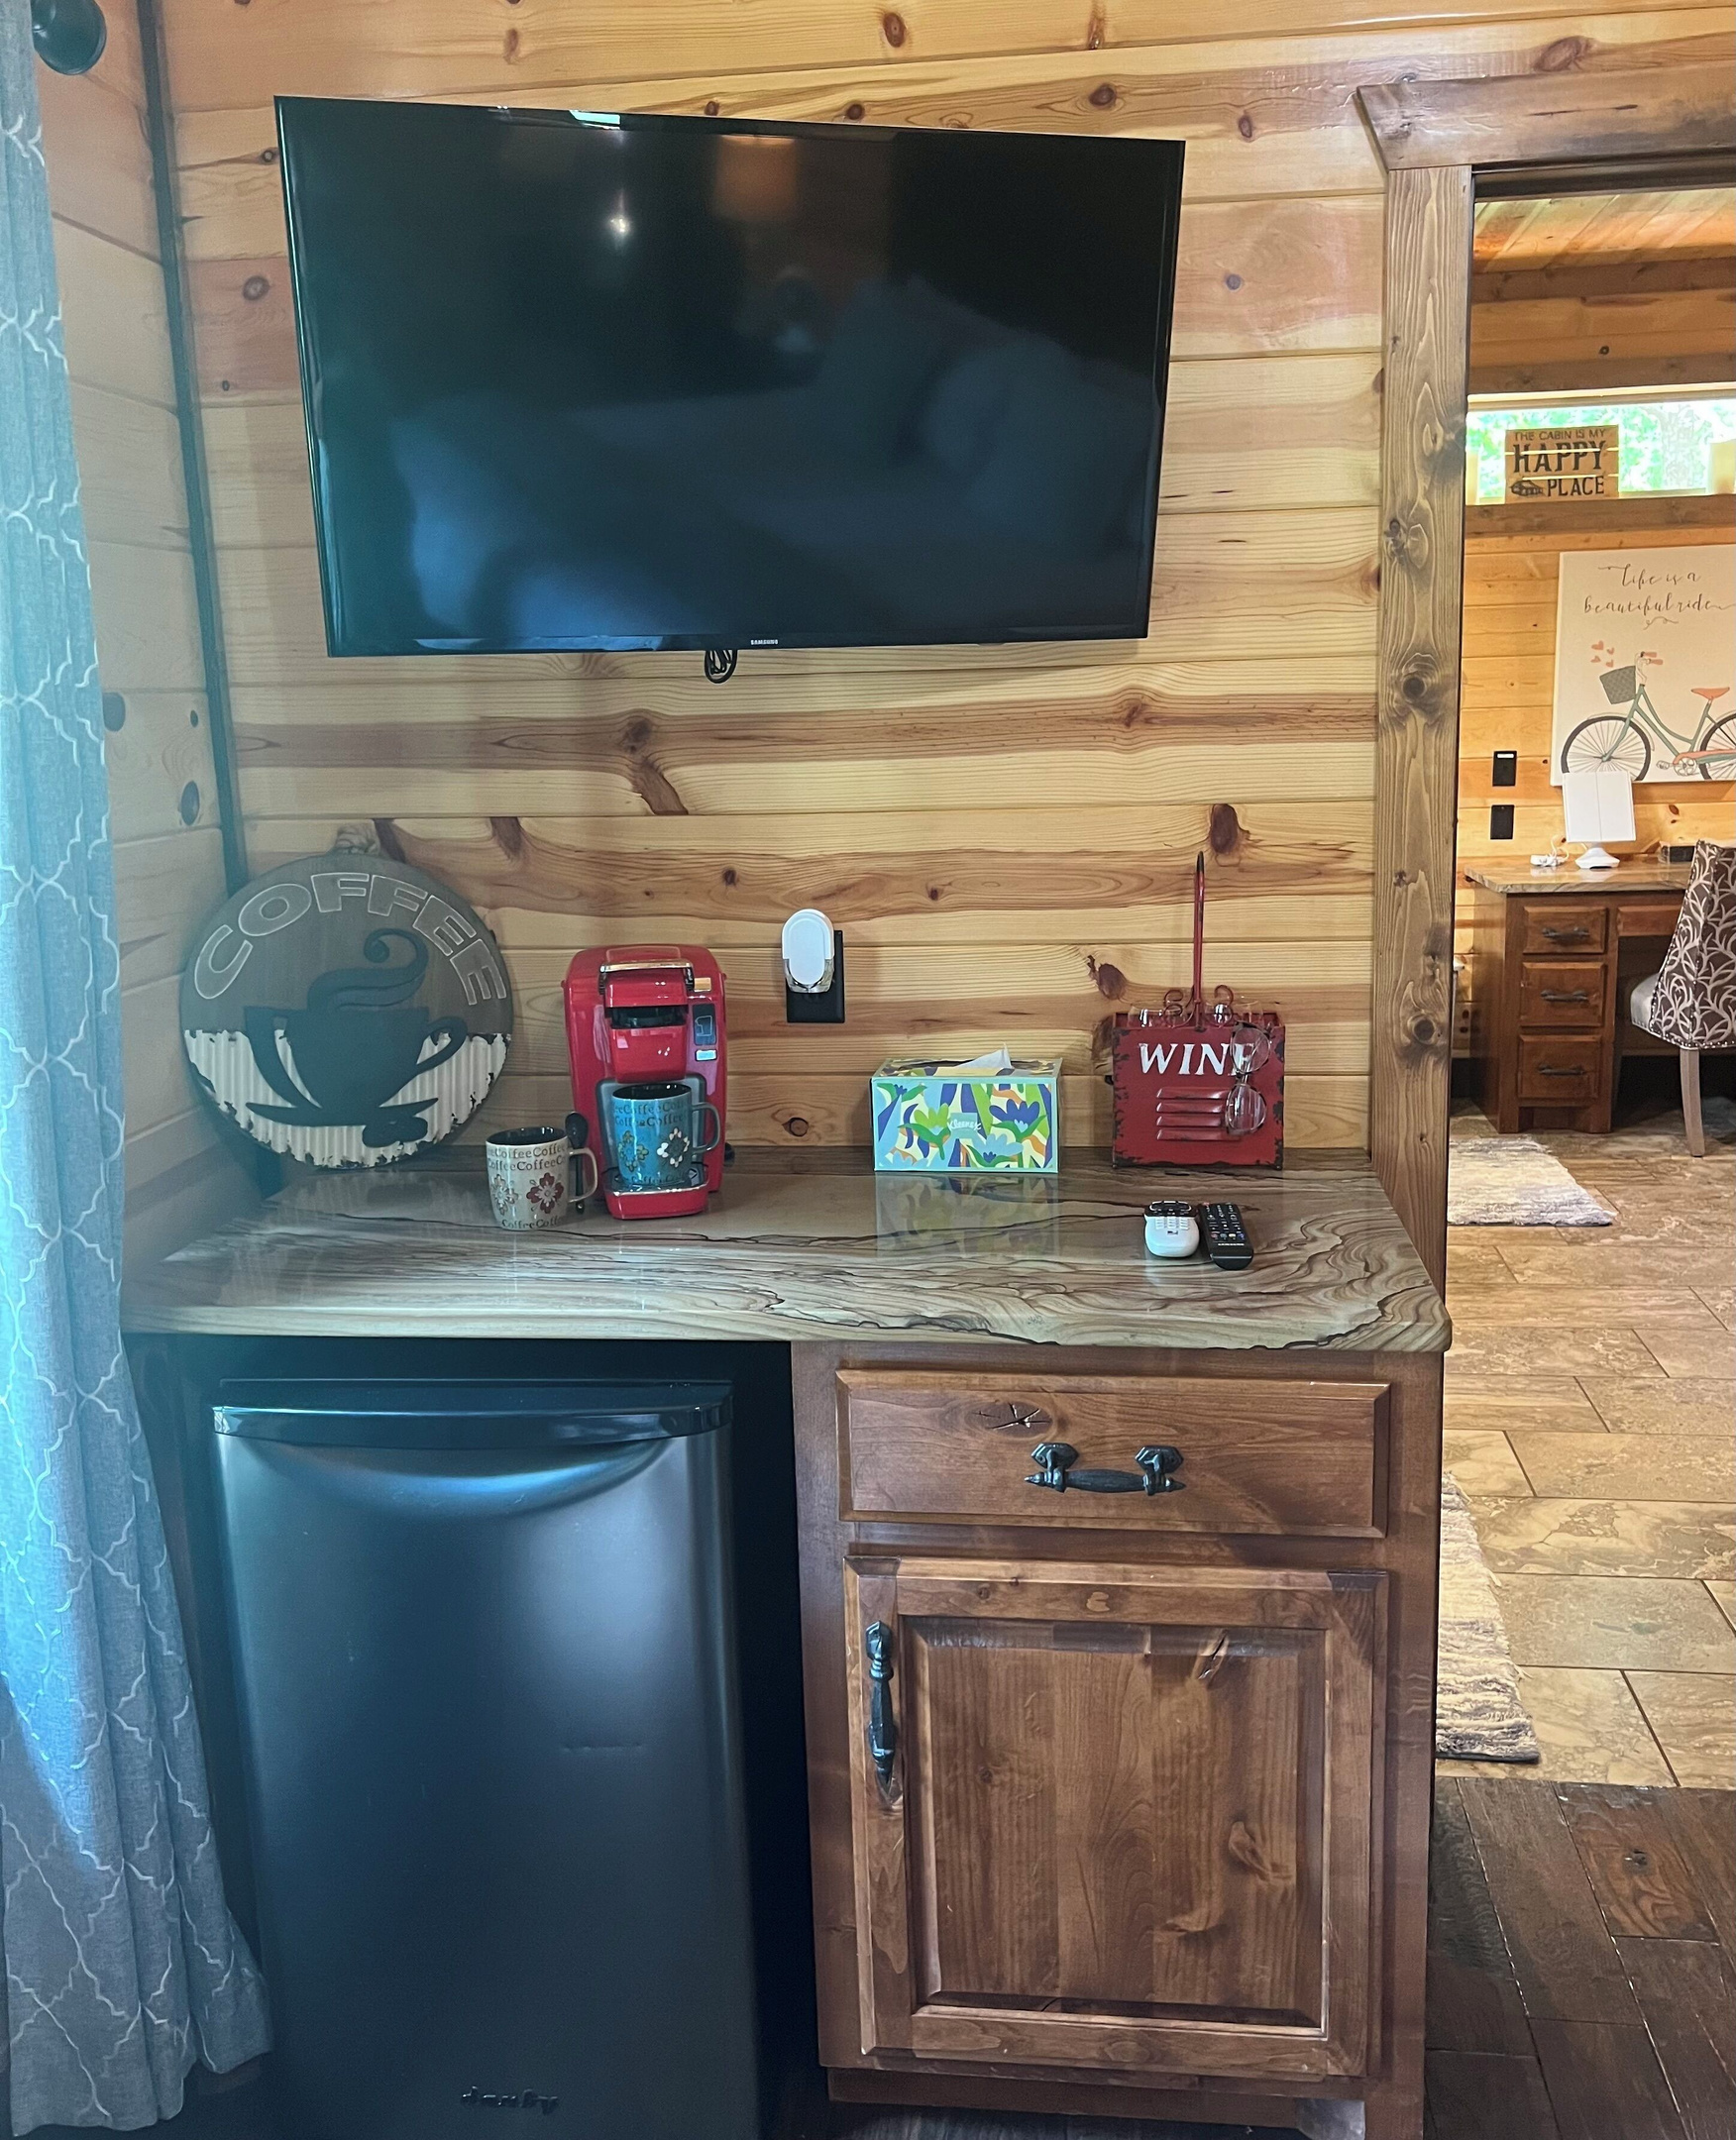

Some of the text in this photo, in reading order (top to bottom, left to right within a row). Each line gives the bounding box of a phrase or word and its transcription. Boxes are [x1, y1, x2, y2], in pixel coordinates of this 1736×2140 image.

[1514, 428, 1606, 442] THE CABIN IS MY
[1513, 440, 1606, 474] HAPPY
[1547, 476, 1604, 497] PLACE
[1598, 563, 1701, 590] Life is a
[1584, 591, 1726, 616] beautiful ride
[194, 872, 507, 1006] COFFEE
[947, 1119, 982, 1131] Kleenex
[516, 1156, 555, 1171] Coffee
